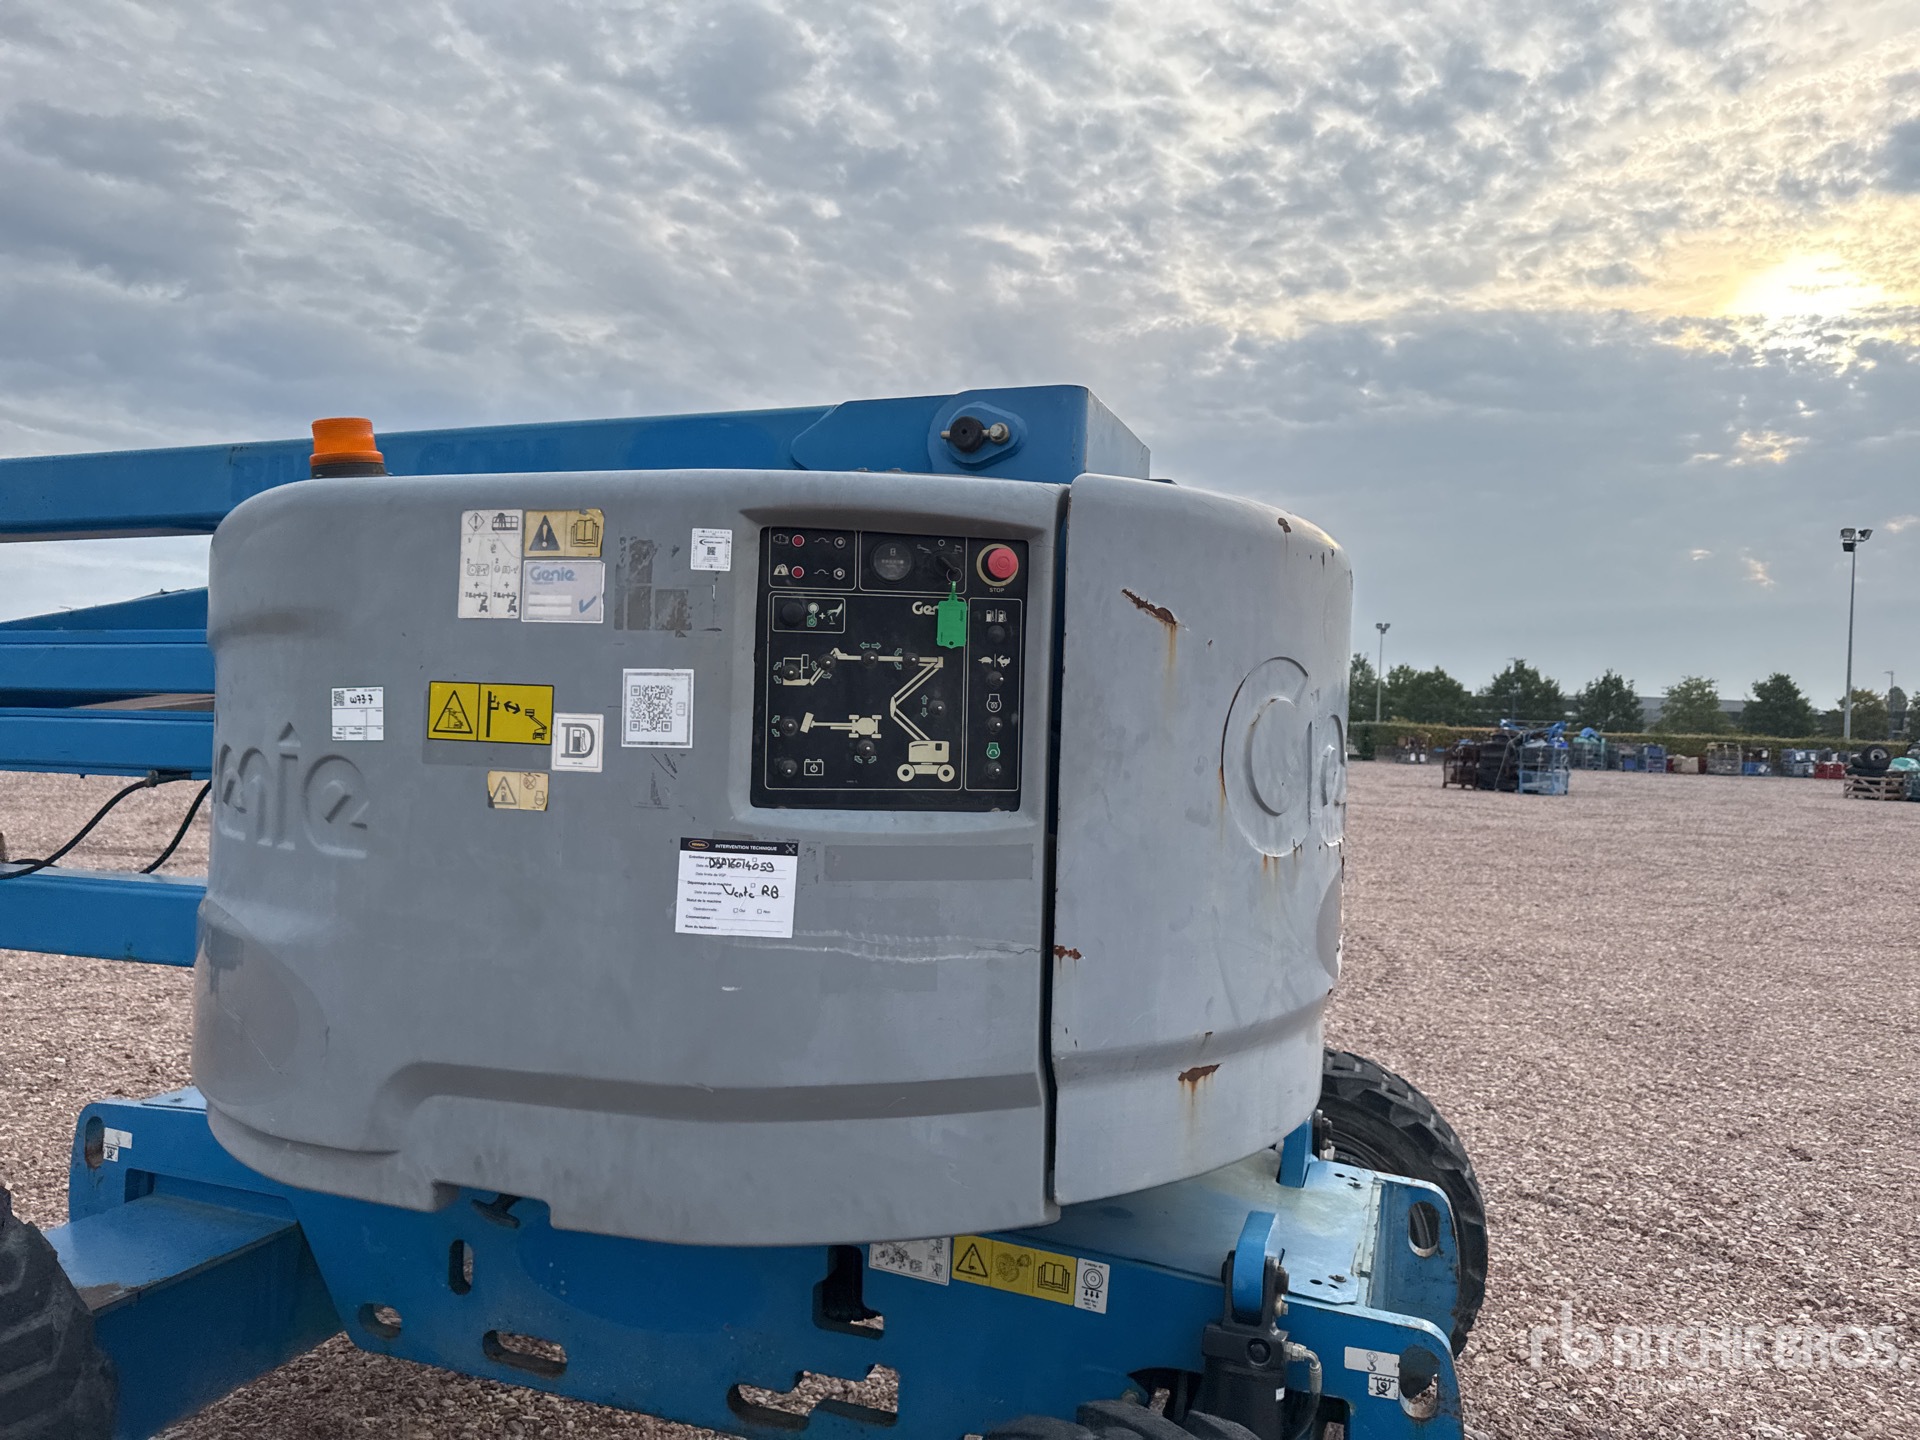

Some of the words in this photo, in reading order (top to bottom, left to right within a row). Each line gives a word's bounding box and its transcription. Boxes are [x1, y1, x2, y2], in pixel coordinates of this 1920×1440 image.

[530, 565, 575, 581] Genie
[215, 721, 370, 859] enie
[761, 884, 779, 899] RB
